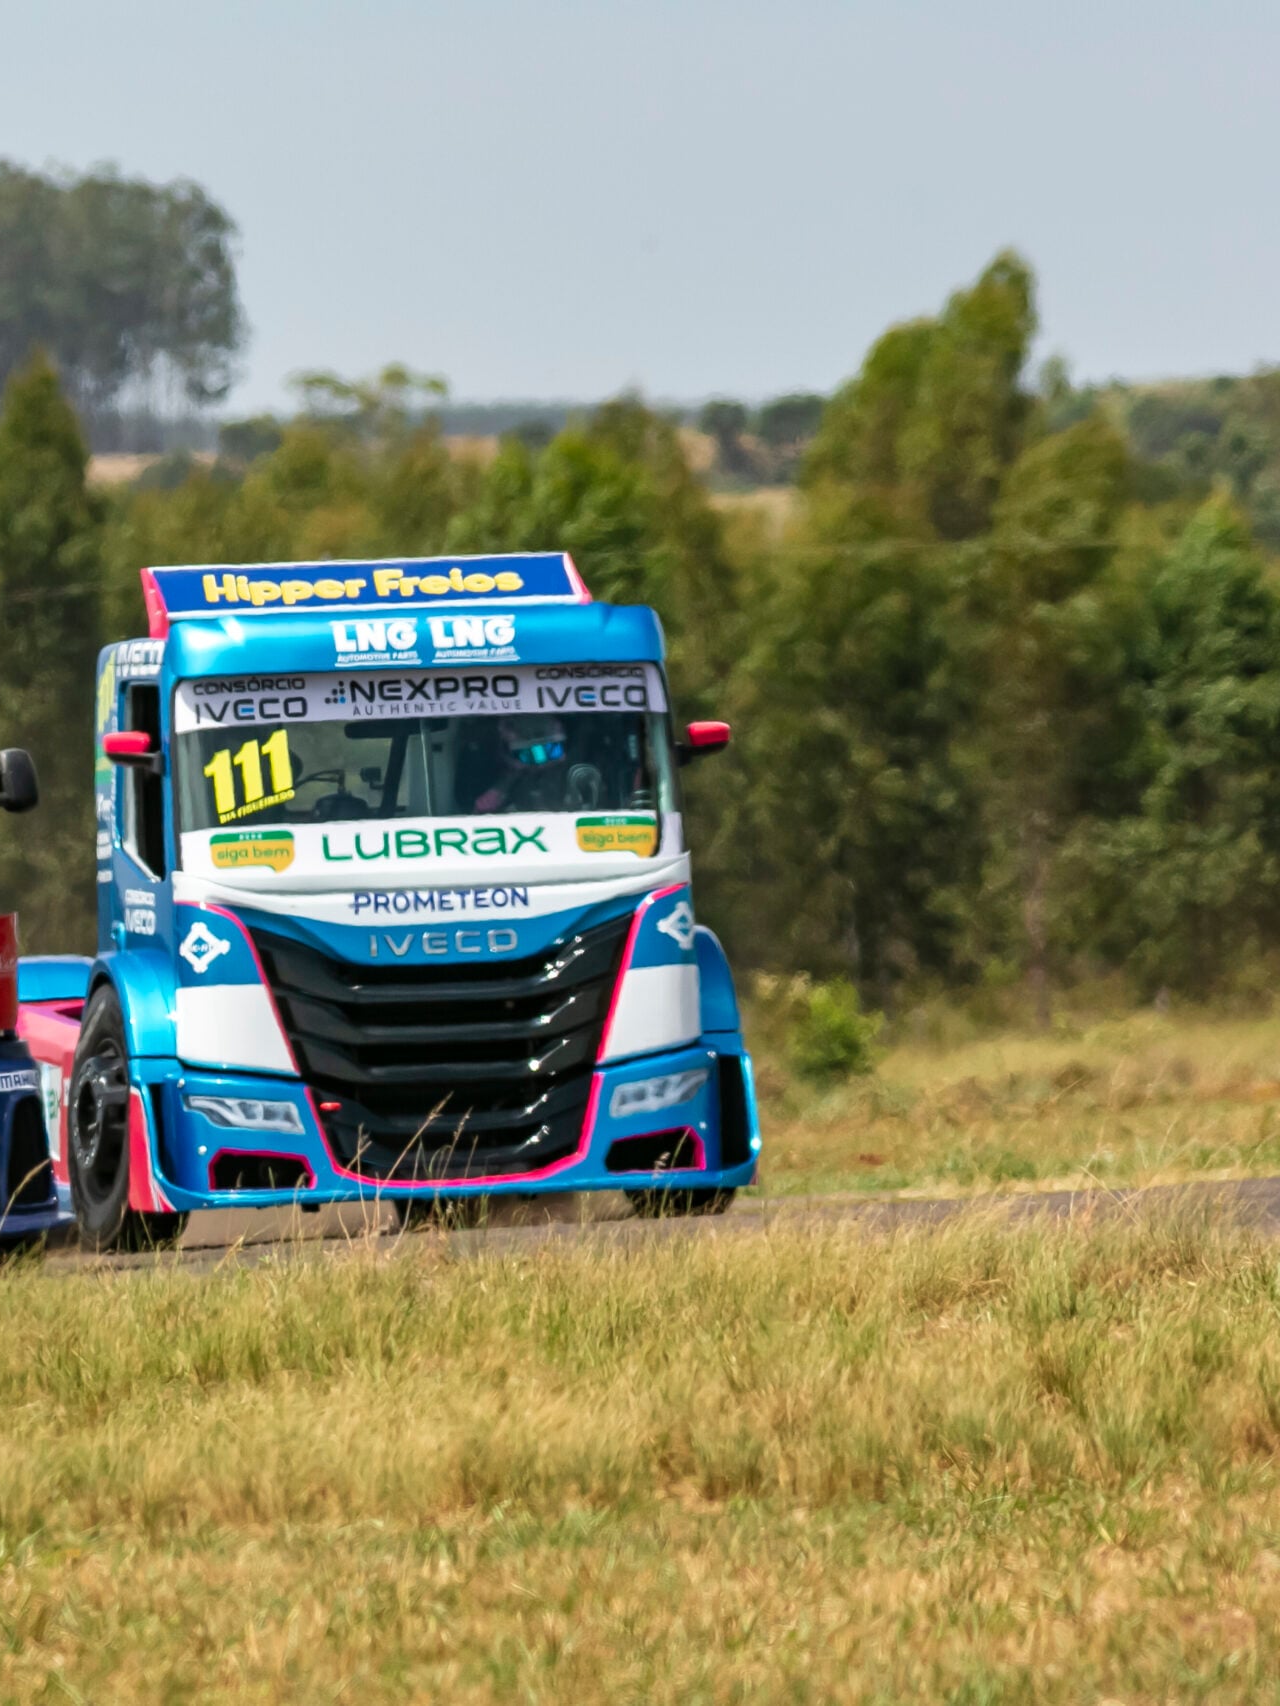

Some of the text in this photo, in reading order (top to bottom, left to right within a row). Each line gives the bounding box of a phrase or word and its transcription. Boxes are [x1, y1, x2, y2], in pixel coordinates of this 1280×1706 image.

[202, 567, 524, 606] Hipper Freios
[331, 617, 516, 652] LNG LNG
[349, 674, 519, 703] NEXPRO
[536, 684, 647, 708] IVECO
[195, 696, 308, 724] IVECO
[352, 699, 522, 716] AUTHENTIC VALUE
[204, 729, 294, 815] 111
[253, 845, 290, 858] bem
[348, 886, 530, 915] PROMETEON
[370, 928, 519, 957] IVECO
